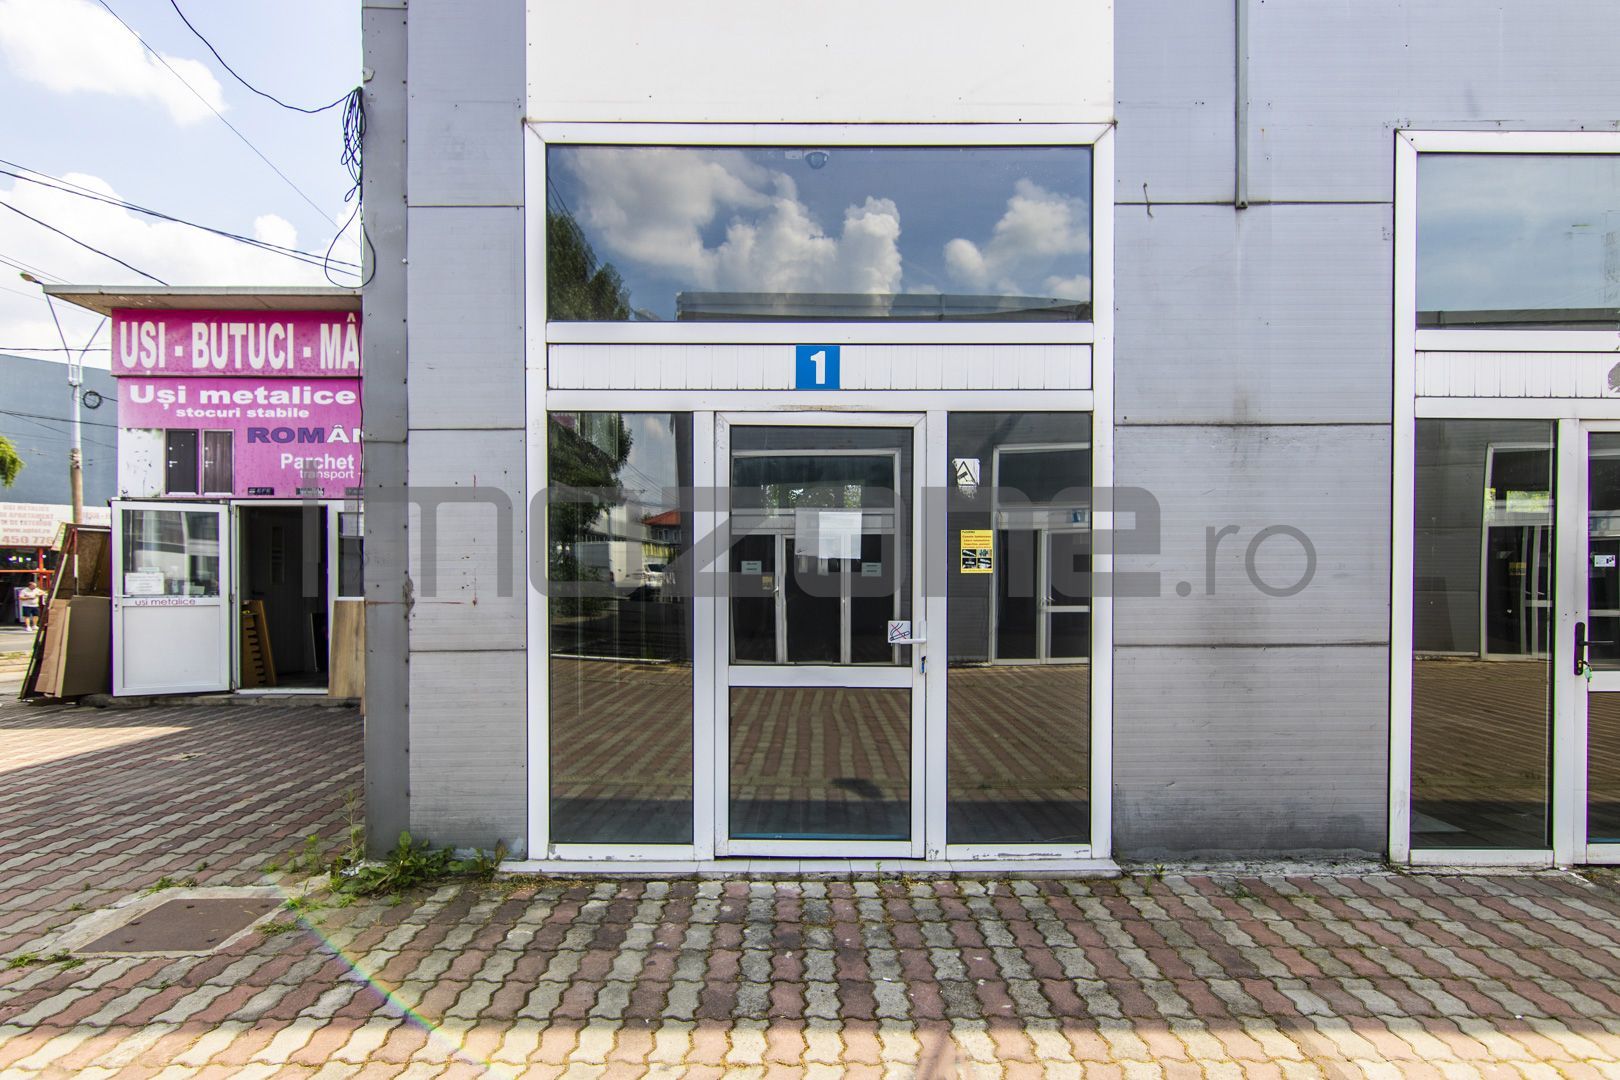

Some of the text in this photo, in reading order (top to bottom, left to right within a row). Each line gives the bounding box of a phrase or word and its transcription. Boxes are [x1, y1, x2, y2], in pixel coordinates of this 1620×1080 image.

[192, 322, 294, 369] BUTUCI
[320, 312, 363, 369] MÂ
[811, 351, 825, 384] 1
[200, 386, 356, 405] metalice
[176, 408, 310, 417] stocuri stabile
[281, 453, 354, 469] Parchet
[300, 470, 354, 480] transport
